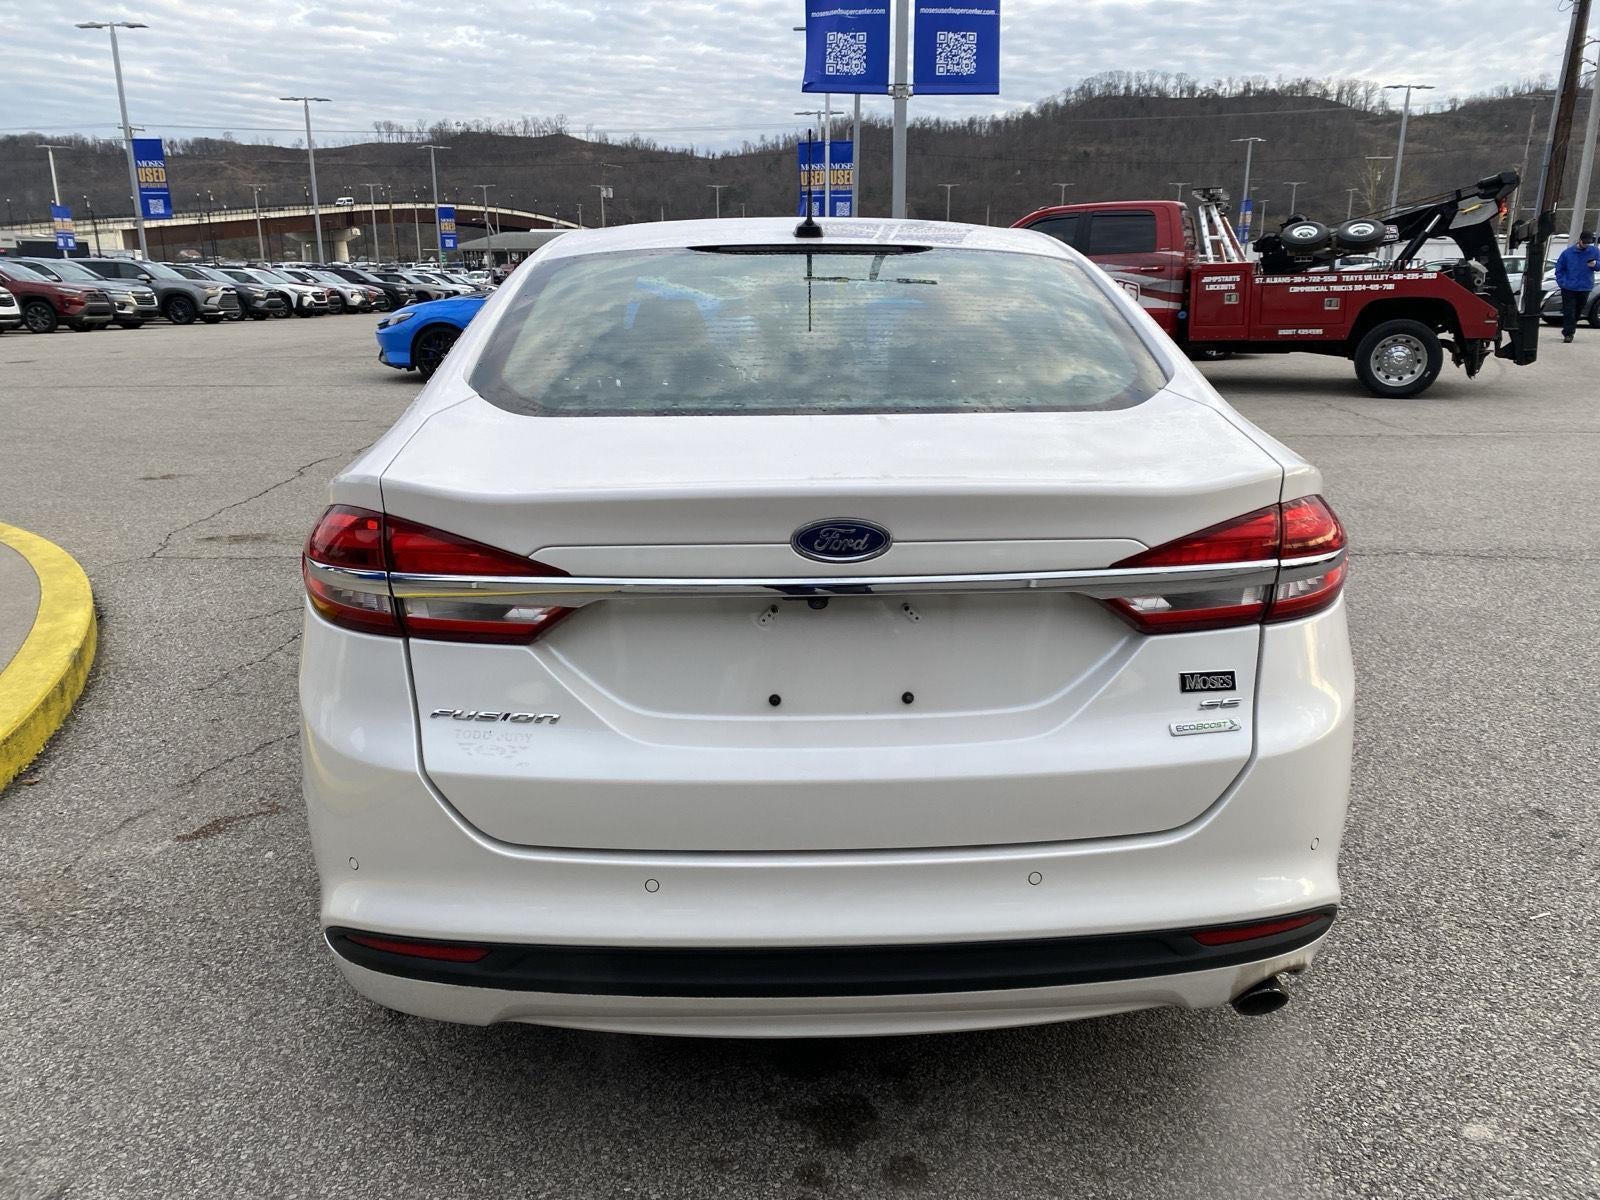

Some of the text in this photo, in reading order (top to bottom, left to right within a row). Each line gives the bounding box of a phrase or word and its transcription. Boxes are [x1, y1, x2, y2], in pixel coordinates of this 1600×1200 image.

[811, 8, 886, 17] mosesusedsupercenter.com
[920, 7, 995, 15] mosesusedsupercenter.com
[137, 160, 164, 168] MOSES
[138, 167, 166, 182] USED
[813, 527, 870, 552] Ford
[1184, 674, 1233, 690] MOSES
[1198, 698, 1242, 711] SE
